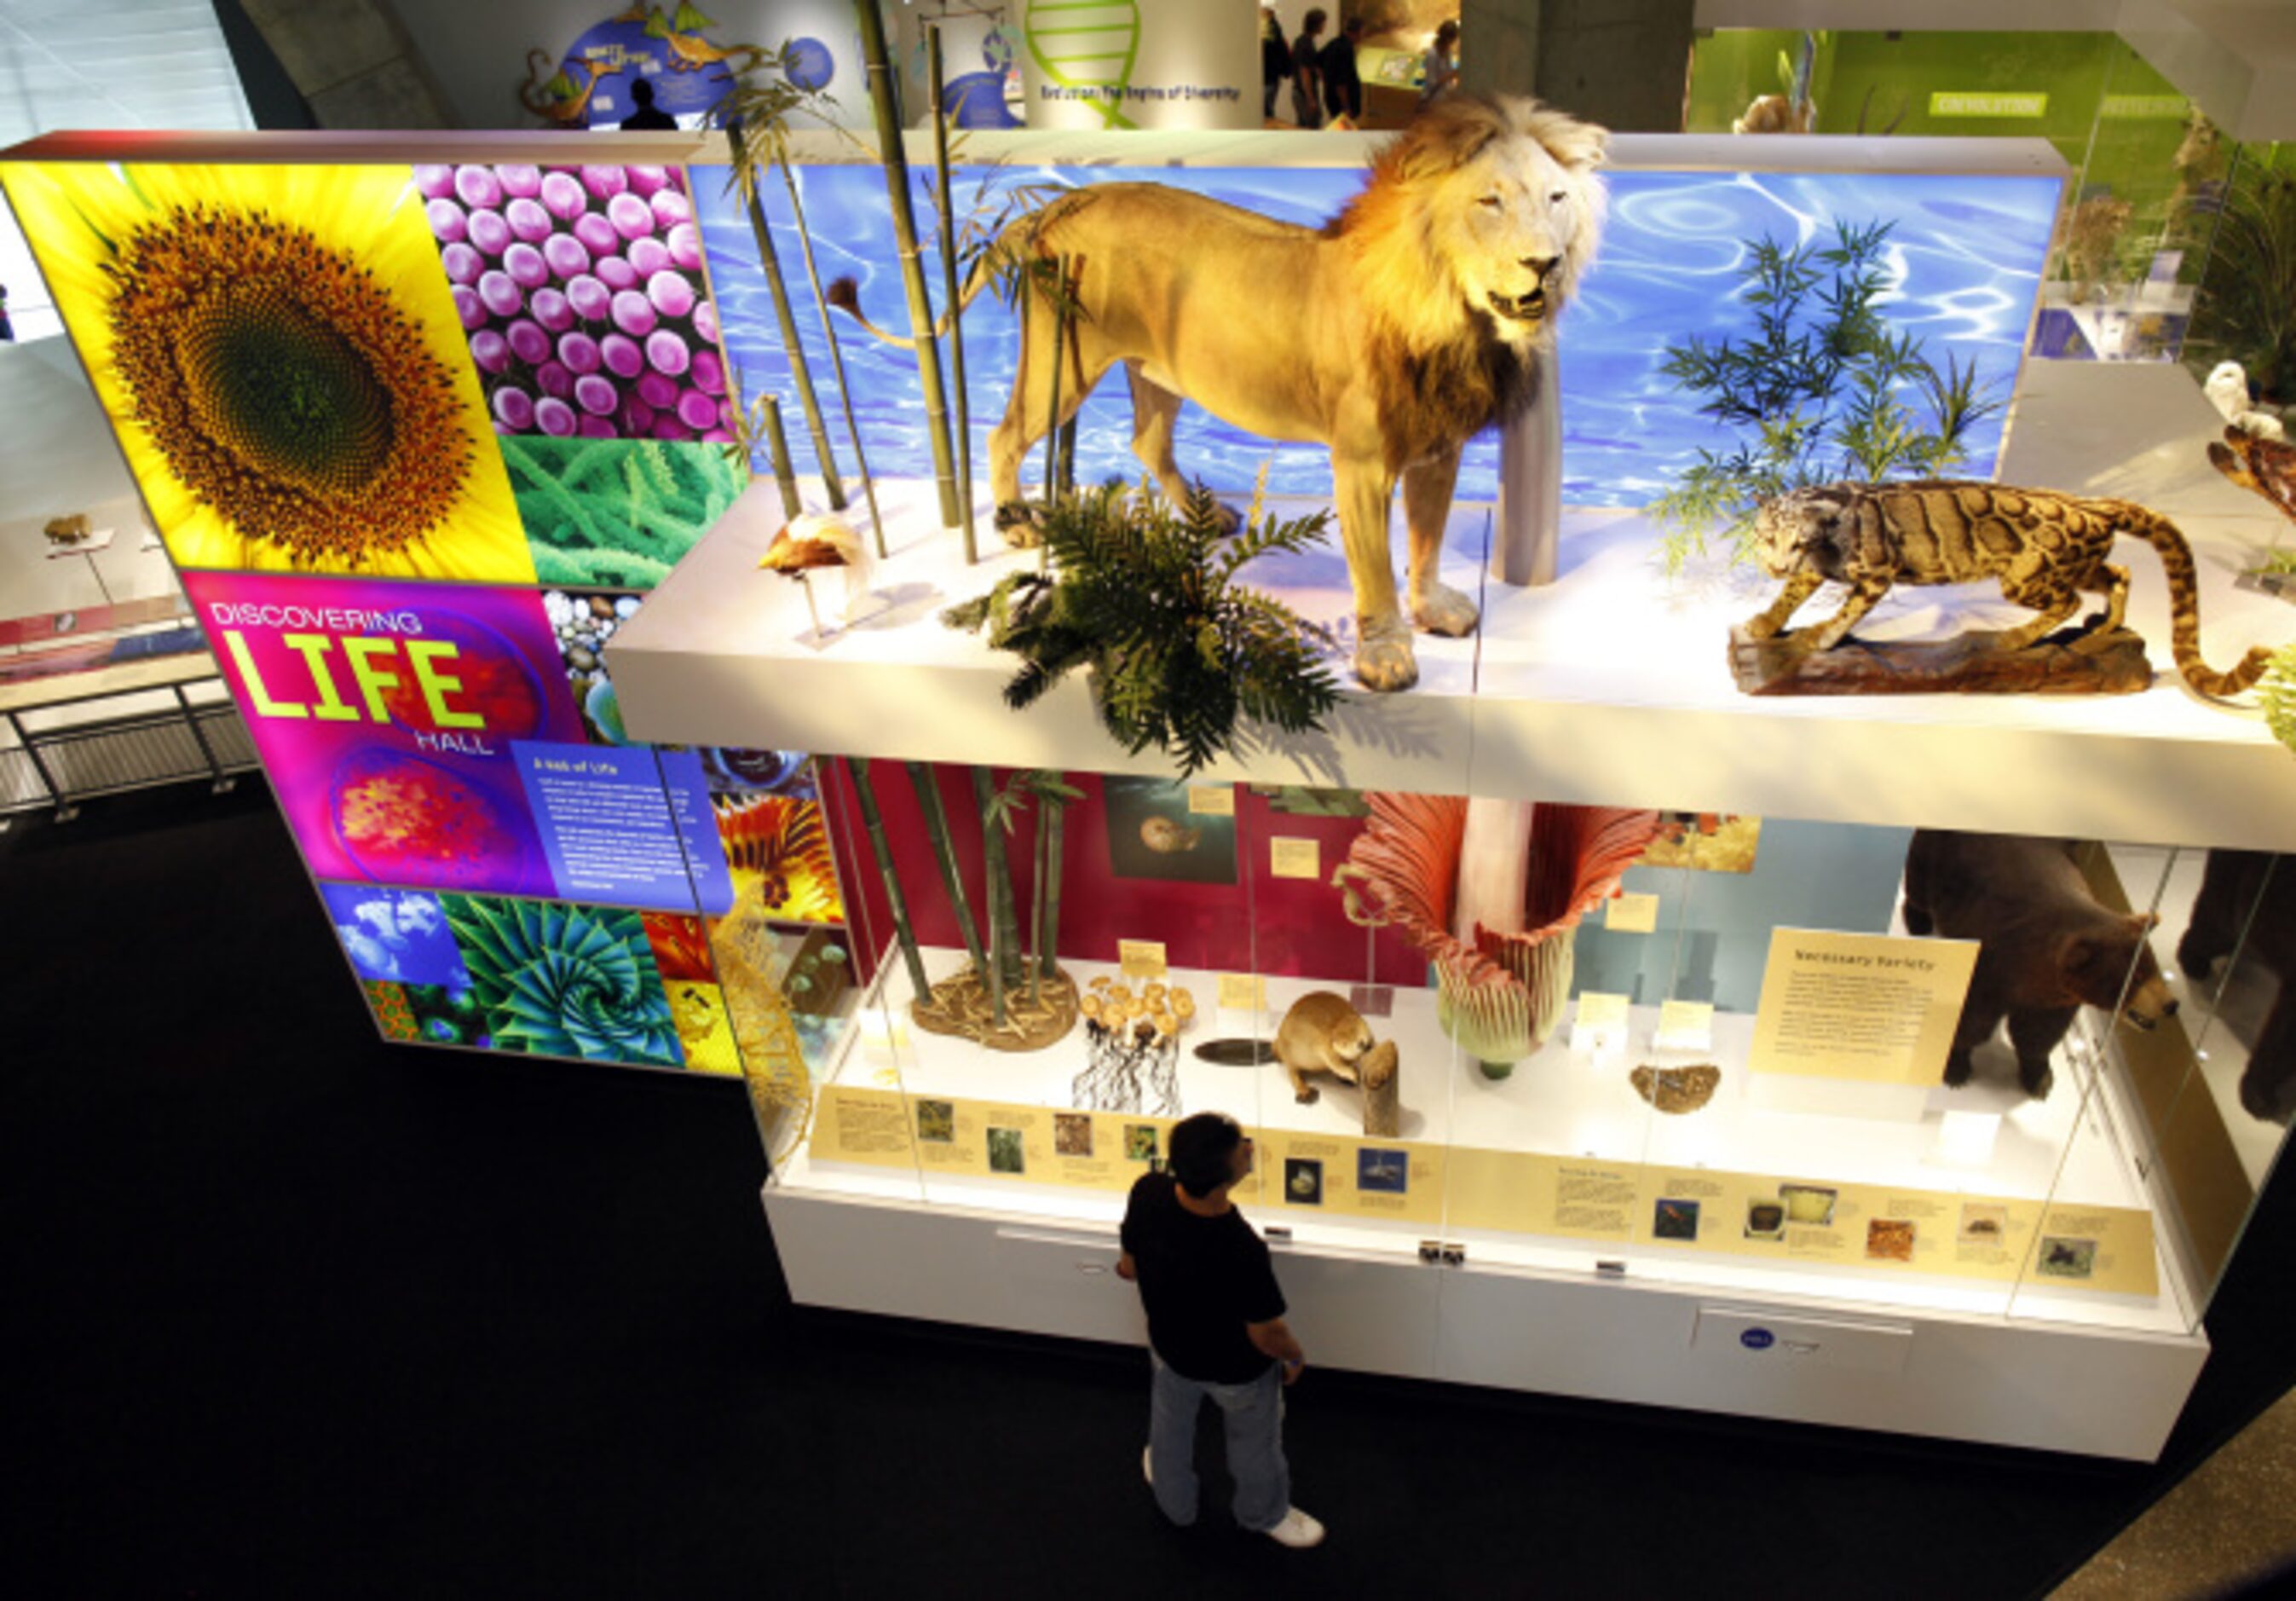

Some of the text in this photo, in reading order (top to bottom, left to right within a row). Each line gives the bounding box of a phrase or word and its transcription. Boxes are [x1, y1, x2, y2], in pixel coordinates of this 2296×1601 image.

[1168, 84, 1182, 101] of
[210, 602, 423, 633] DISCOVERING
[222, 631, 486, 729] LIFE
[413, 730, 495, 755] HALL
[1794, 949, 1935, 972] Necessary Variety
